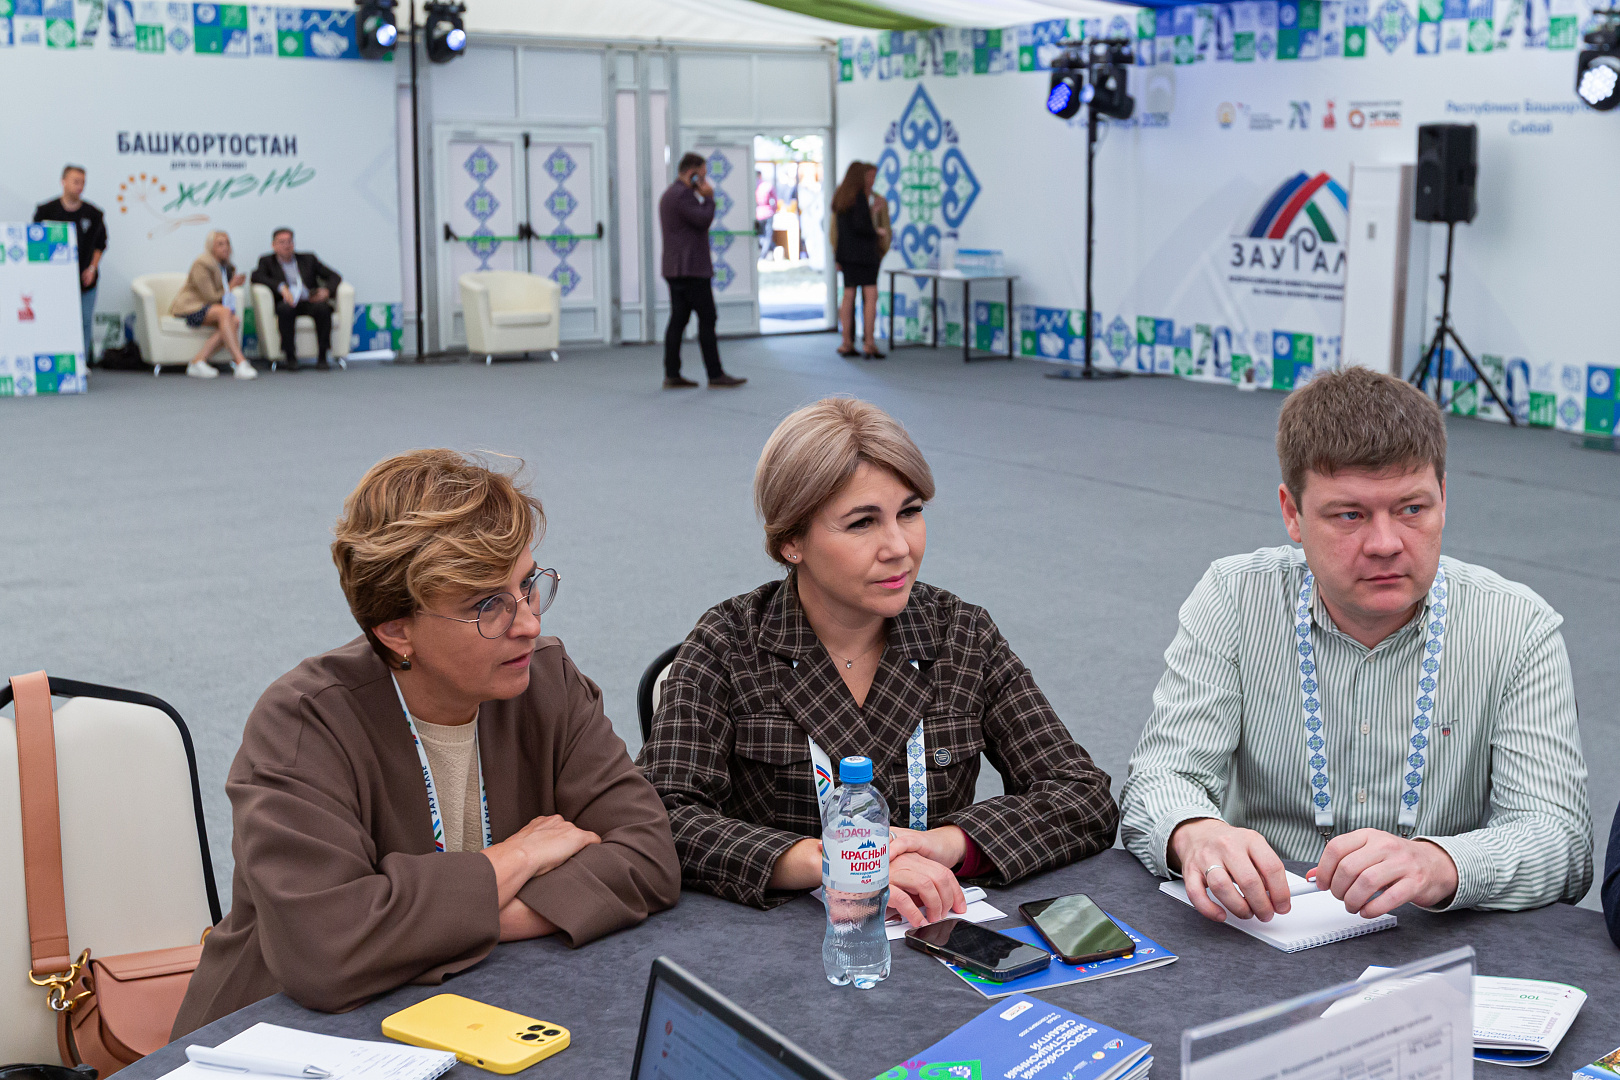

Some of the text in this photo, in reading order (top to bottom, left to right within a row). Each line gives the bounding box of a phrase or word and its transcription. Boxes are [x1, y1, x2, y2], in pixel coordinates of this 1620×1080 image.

[117, 131, 298, 156] БАШКОРТОСТАН
[163, 162, 316, 212] ЖИЗНЬ
[841, 843, 887, 861] КРАСНЫЙ
[850, 859, 881, 872] КЛЮЧ
[1004, 1023, 1087, 1079] ИНВЕСТИЦИОННЫЙ
[1030, 1019, 1076, 1051] САБАНТУЙ
[1021, 1027, 1098, 1079] ВСЕРОССИЙСКИЙ
